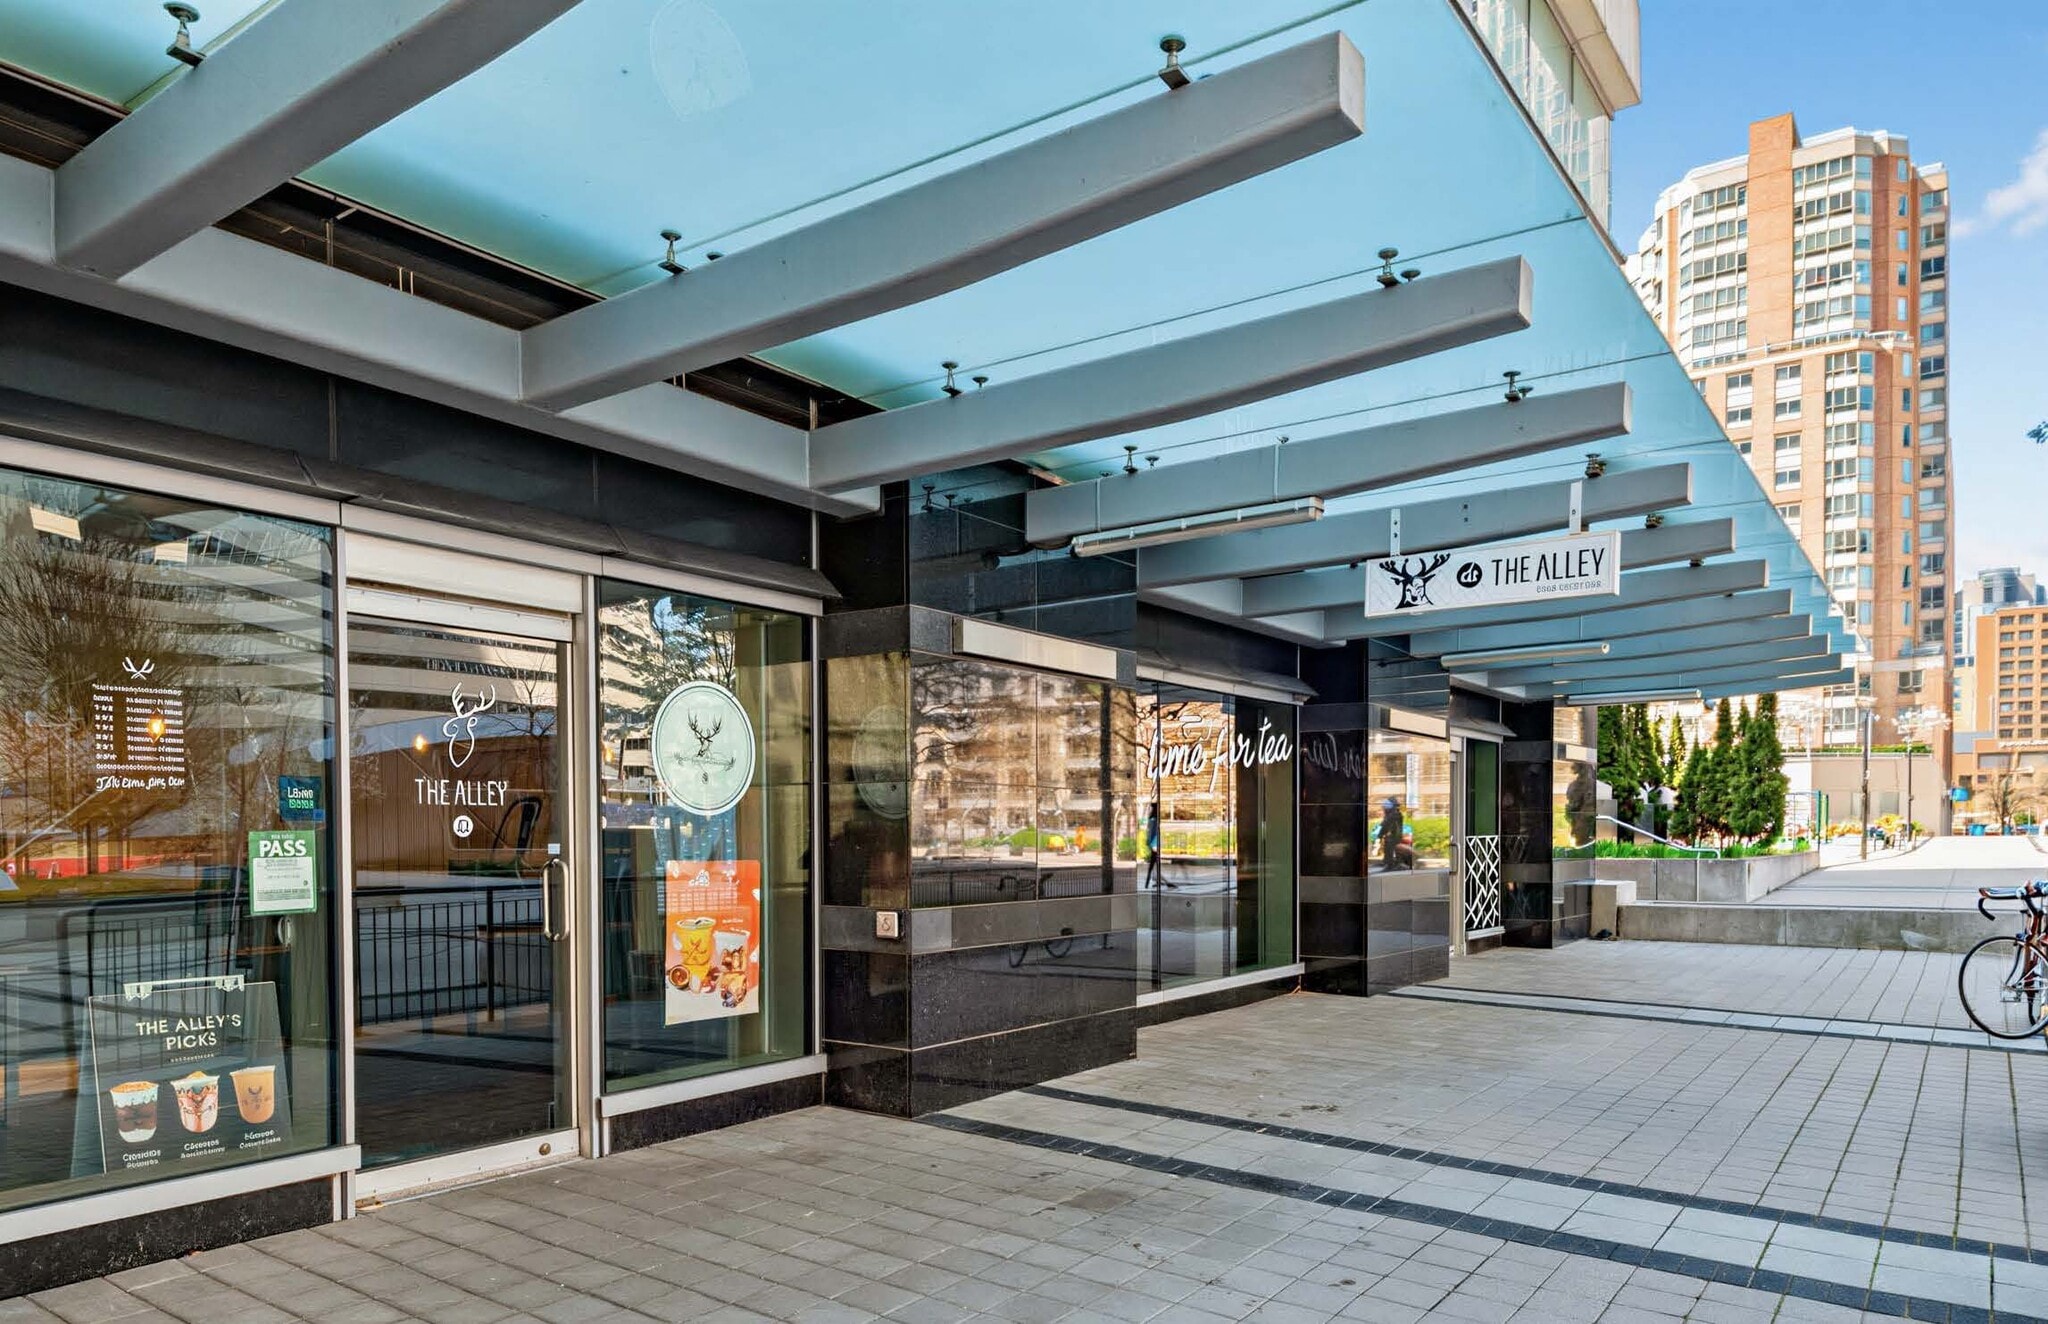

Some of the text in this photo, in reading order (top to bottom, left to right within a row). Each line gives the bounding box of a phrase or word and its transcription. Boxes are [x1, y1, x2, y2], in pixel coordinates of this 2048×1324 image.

[1491, 547, 1606, 586] THE ALLEY
[1258, 716, 1293, 765] tea
[414, 777, 508, 807] THE ALLEY
[259, 839, 307, 857] PASS
[135, 1013, 242, 1036] THE ALLEY'S
[166, 1031, 218, 1050] PICKS
